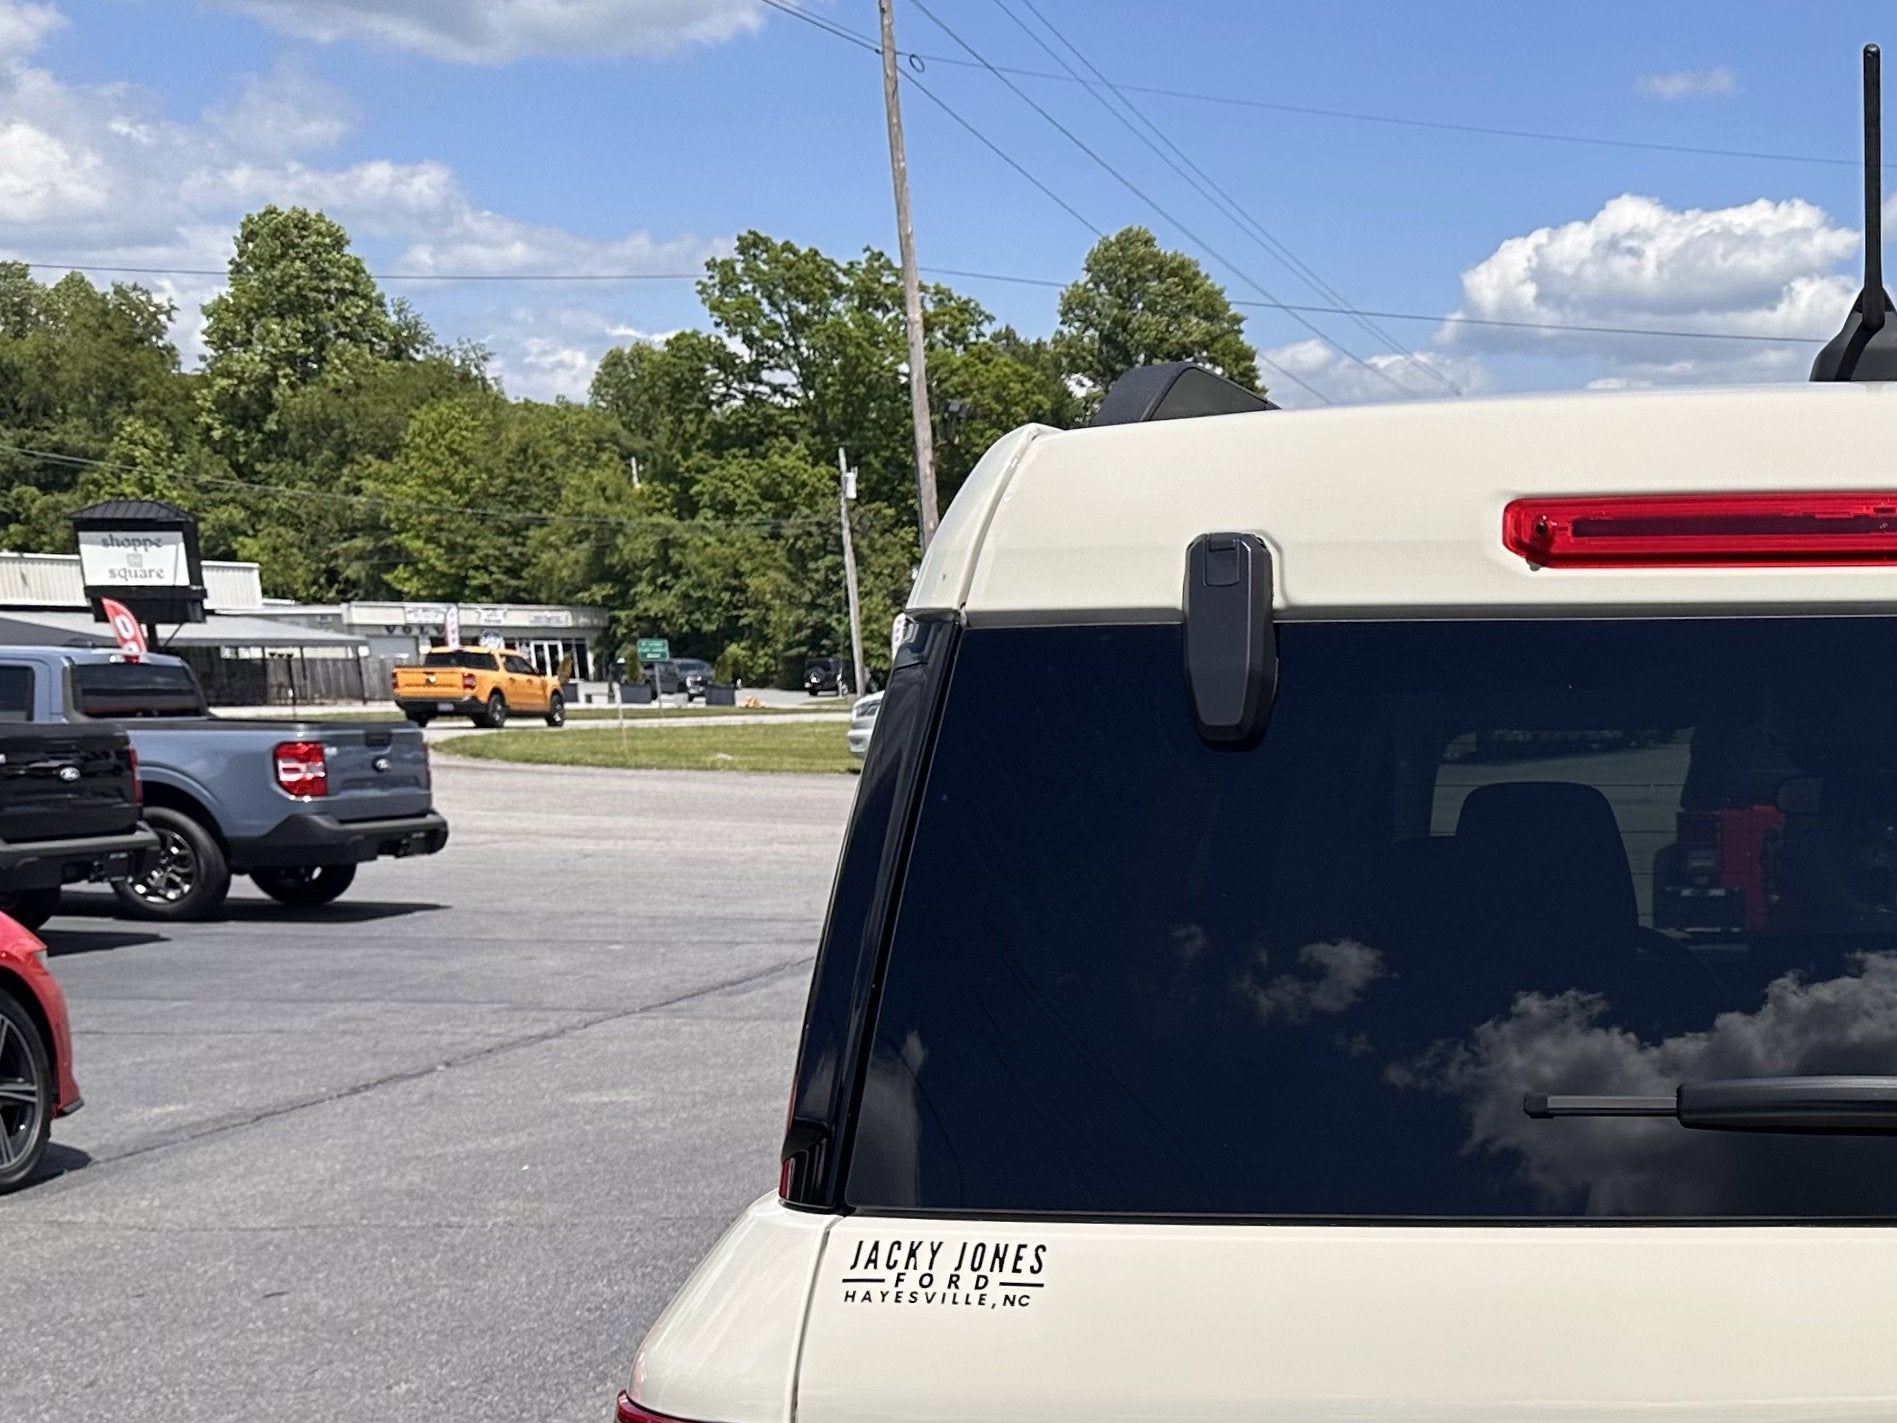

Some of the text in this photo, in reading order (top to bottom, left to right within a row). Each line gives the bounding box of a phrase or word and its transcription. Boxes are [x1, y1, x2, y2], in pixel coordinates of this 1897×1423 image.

[101, 534, 163, 552] shoppe
[108, 567, 165, 581] square
[850, 1240, 1047, 1275] JACKY JONES
[894, 1272, 989, 1291] FORD
